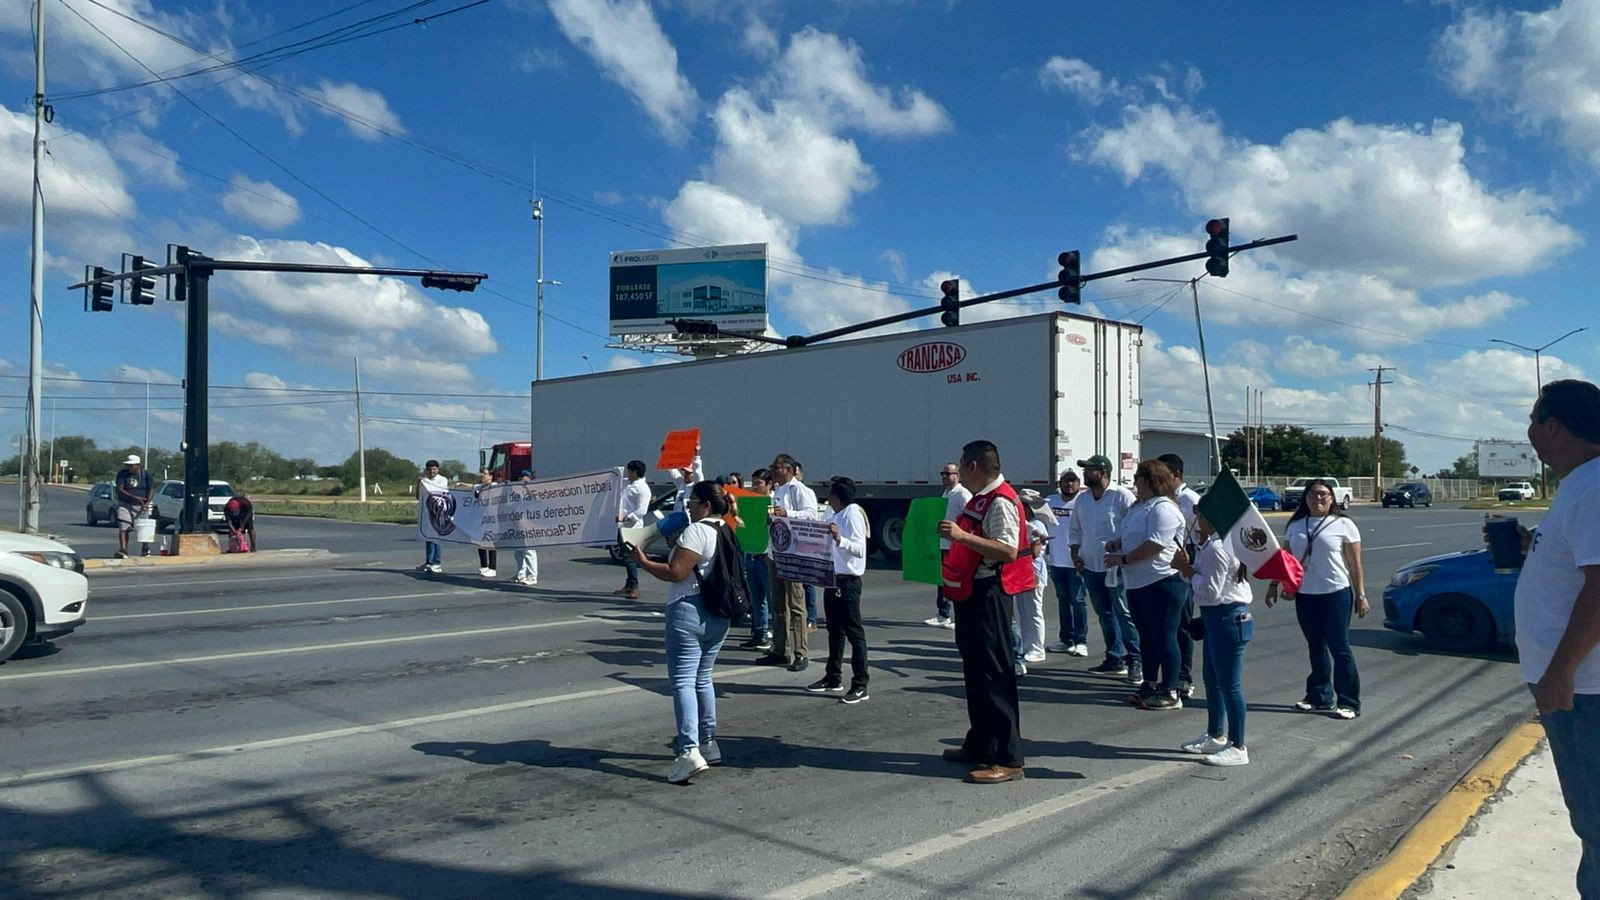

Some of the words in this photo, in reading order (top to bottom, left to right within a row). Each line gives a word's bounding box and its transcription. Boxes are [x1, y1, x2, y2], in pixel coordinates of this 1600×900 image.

[624, 255, 659, 263] PROLOGIS
[901, 344, 961, 370] TRANCASA
[947, 374, 962, 383] USA
[966, 372, 981, 382] INC.
[509, 492, 520, 503] de
[526, 509, 541, 520] tus
[543, 504, 585, 519] derechos
